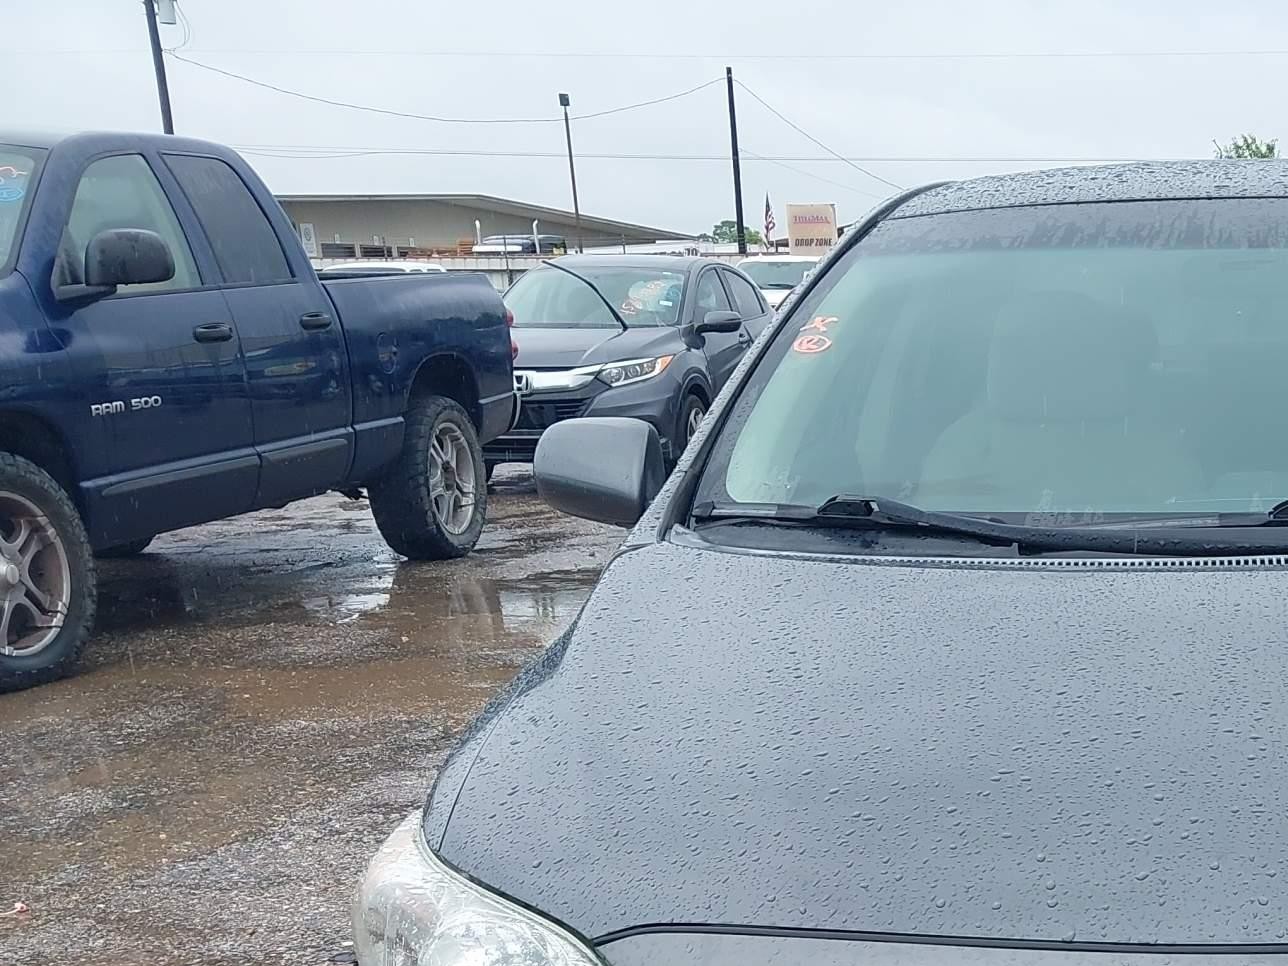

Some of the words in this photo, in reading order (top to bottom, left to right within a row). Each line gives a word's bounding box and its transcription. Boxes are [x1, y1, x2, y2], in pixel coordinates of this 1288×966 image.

[795, 238, 814, 247] DROP
[815, 238, 833, 247] ZONE
[91, 401, 125, 416] RAM
[131, 396, 161, 410] 500
